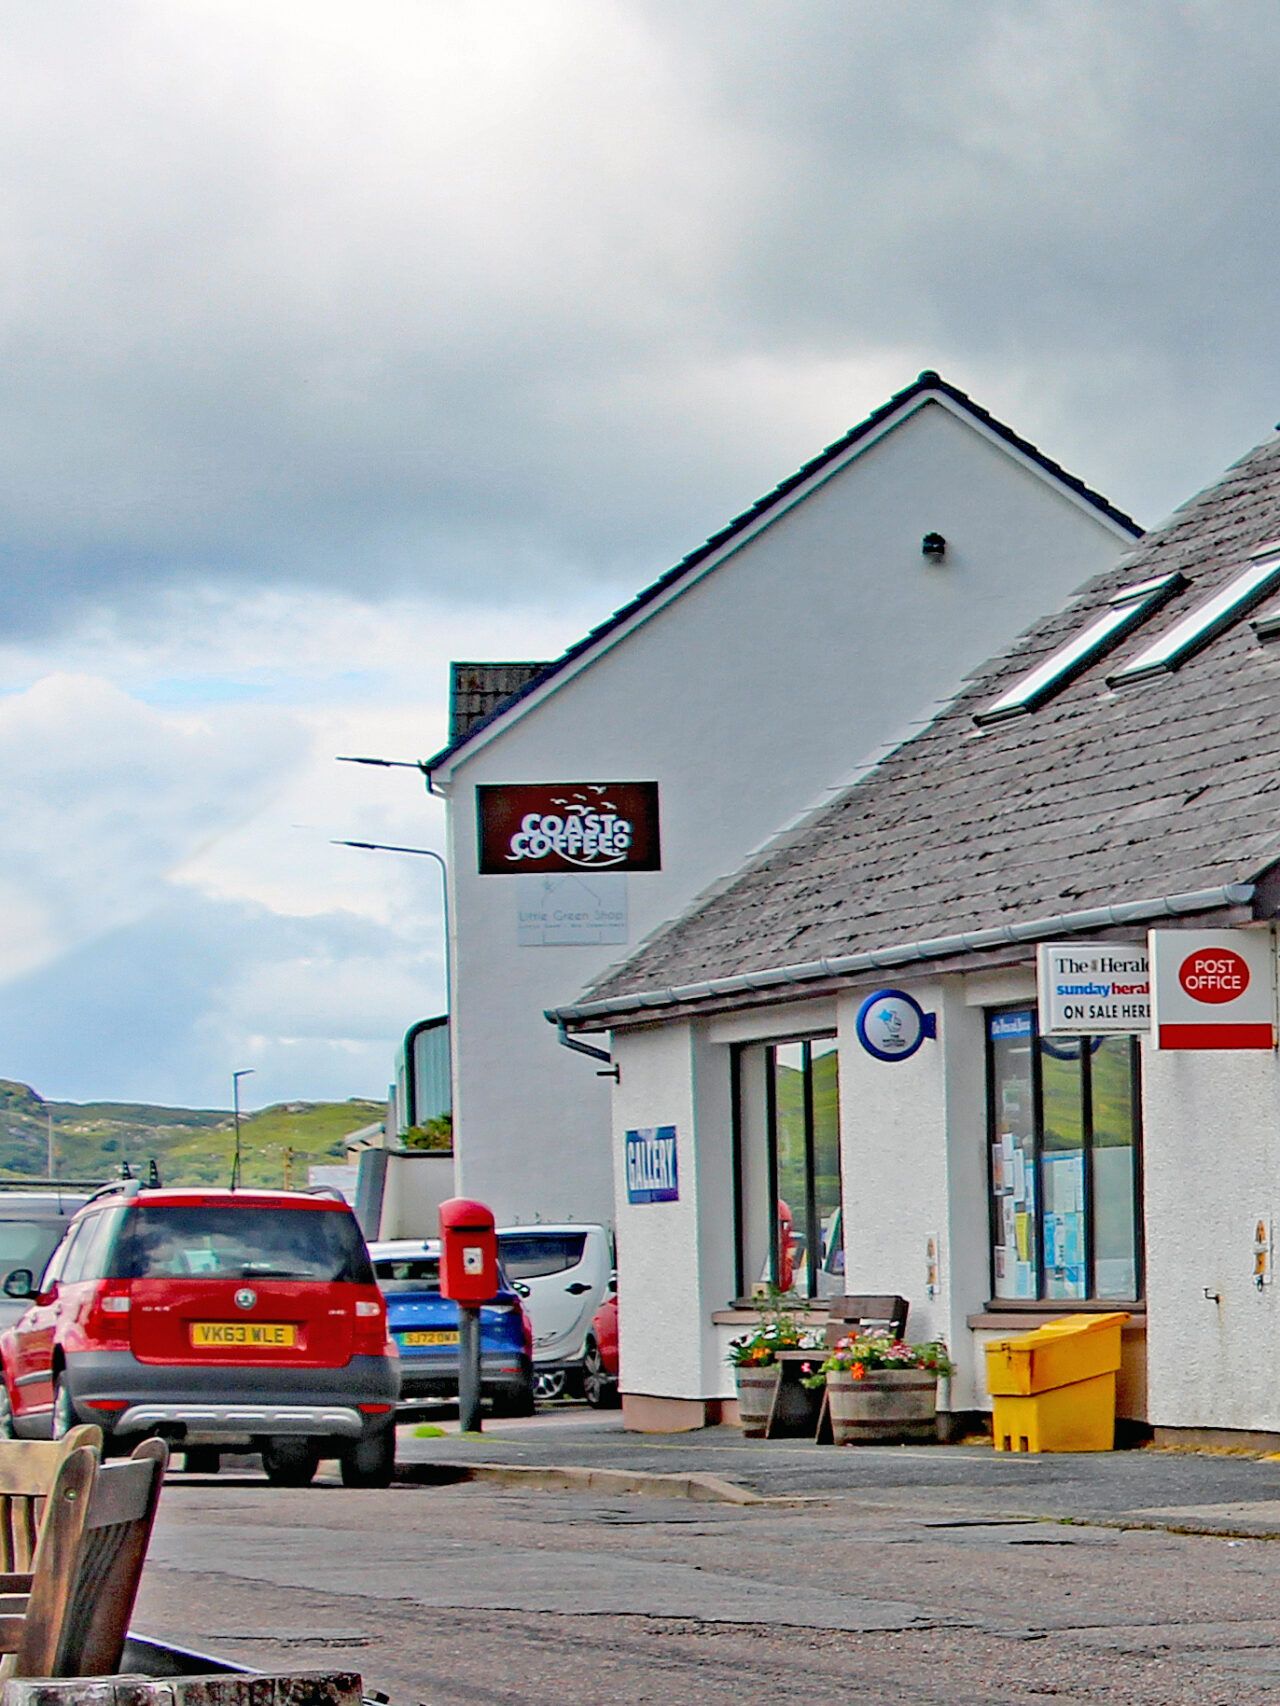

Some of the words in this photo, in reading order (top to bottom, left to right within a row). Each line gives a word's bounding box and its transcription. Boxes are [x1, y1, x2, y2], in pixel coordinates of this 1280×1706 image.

[521, 812, 618, 837] COAST
[505, 832, 614, 862] COFFEE
[1055, 957, 1089, 974] The
[1194, 959, 1236, 974] POST
[1184, 975, 1242, 991] OFFICE
[1063, 1004, 1085, 1019] ON
[1090, 1003, 1118, 1018] SALE
[627, 1138, 675, 1191] GALLERY
[199, 1325, 246, 1343] VK63
[251, 1326, 286, 1344] WLE
